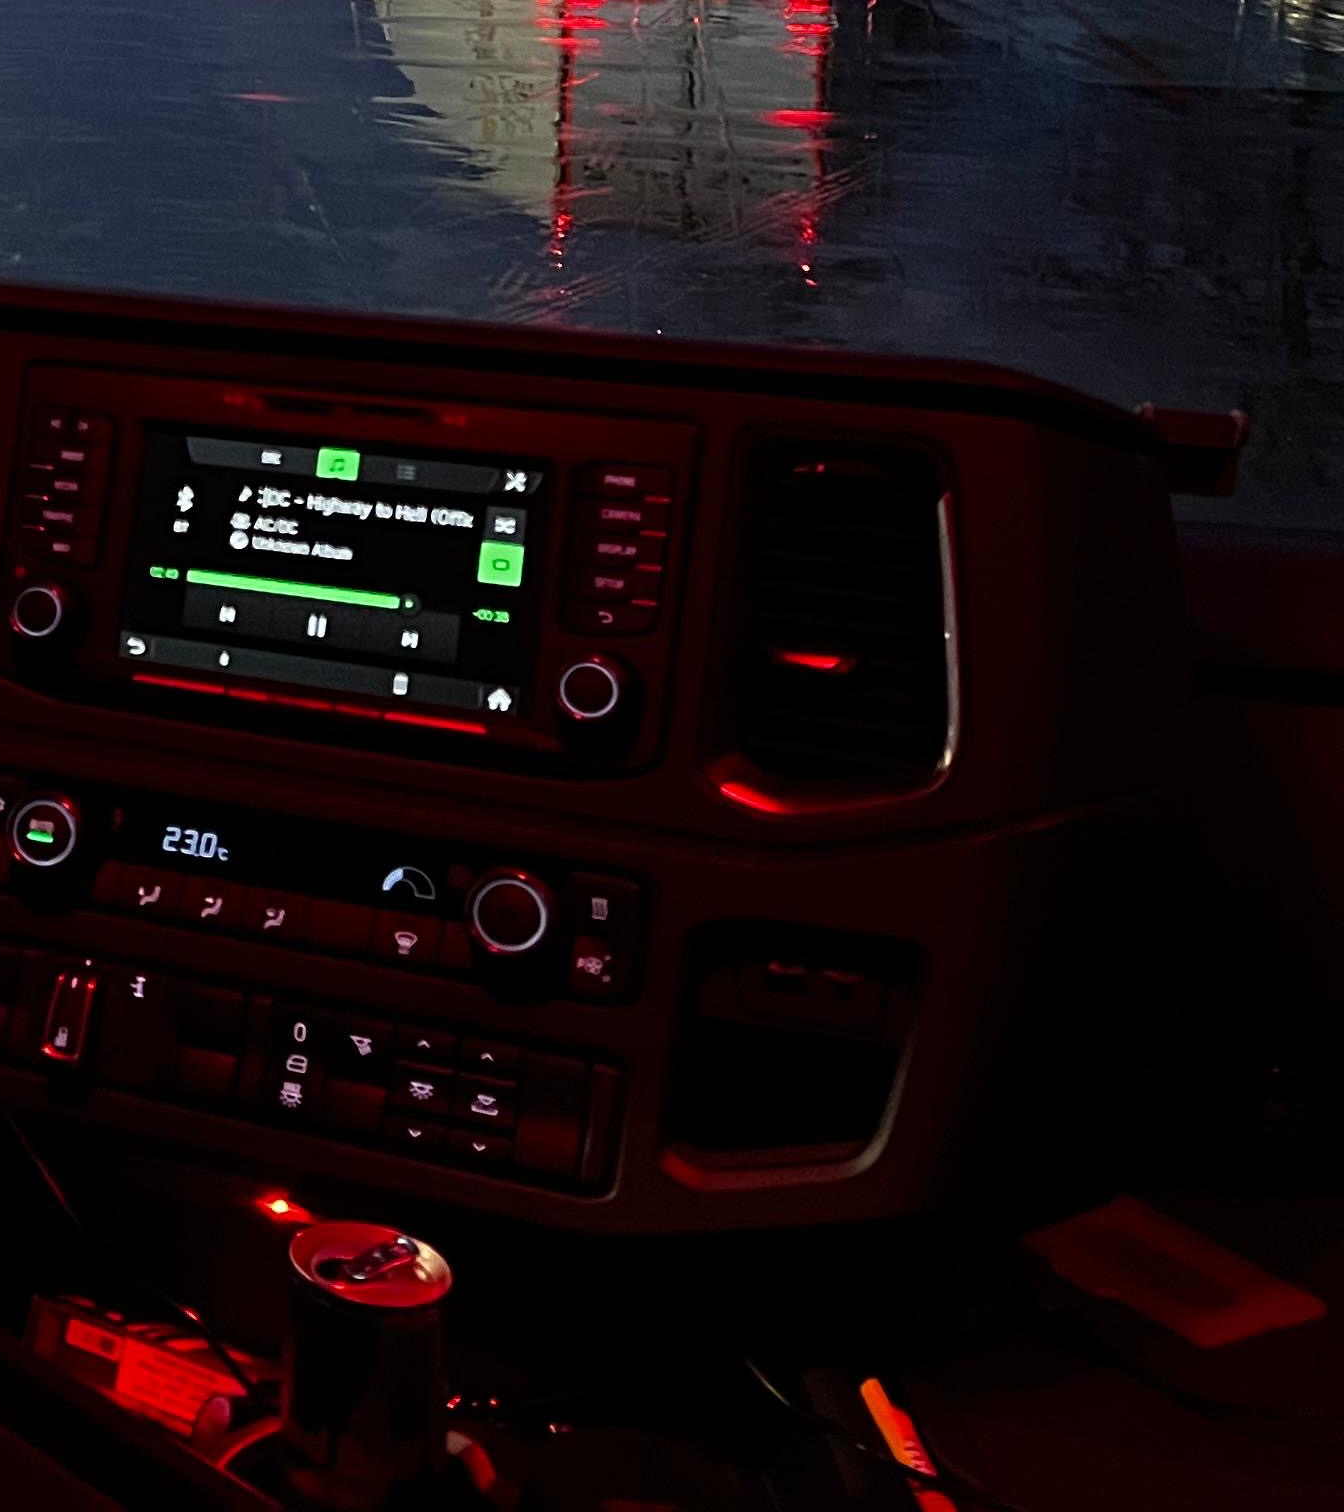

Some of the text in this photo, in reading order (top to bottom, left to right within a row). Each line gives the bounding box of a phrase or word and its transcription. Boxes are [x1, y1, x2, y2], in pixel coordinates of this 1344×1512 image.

[307, 492, 374, 520] Highway
[375, 501, 394, 520] to
[395, 503, 428, 523] Hell
[254, 515, 299, 536] AC/DC
